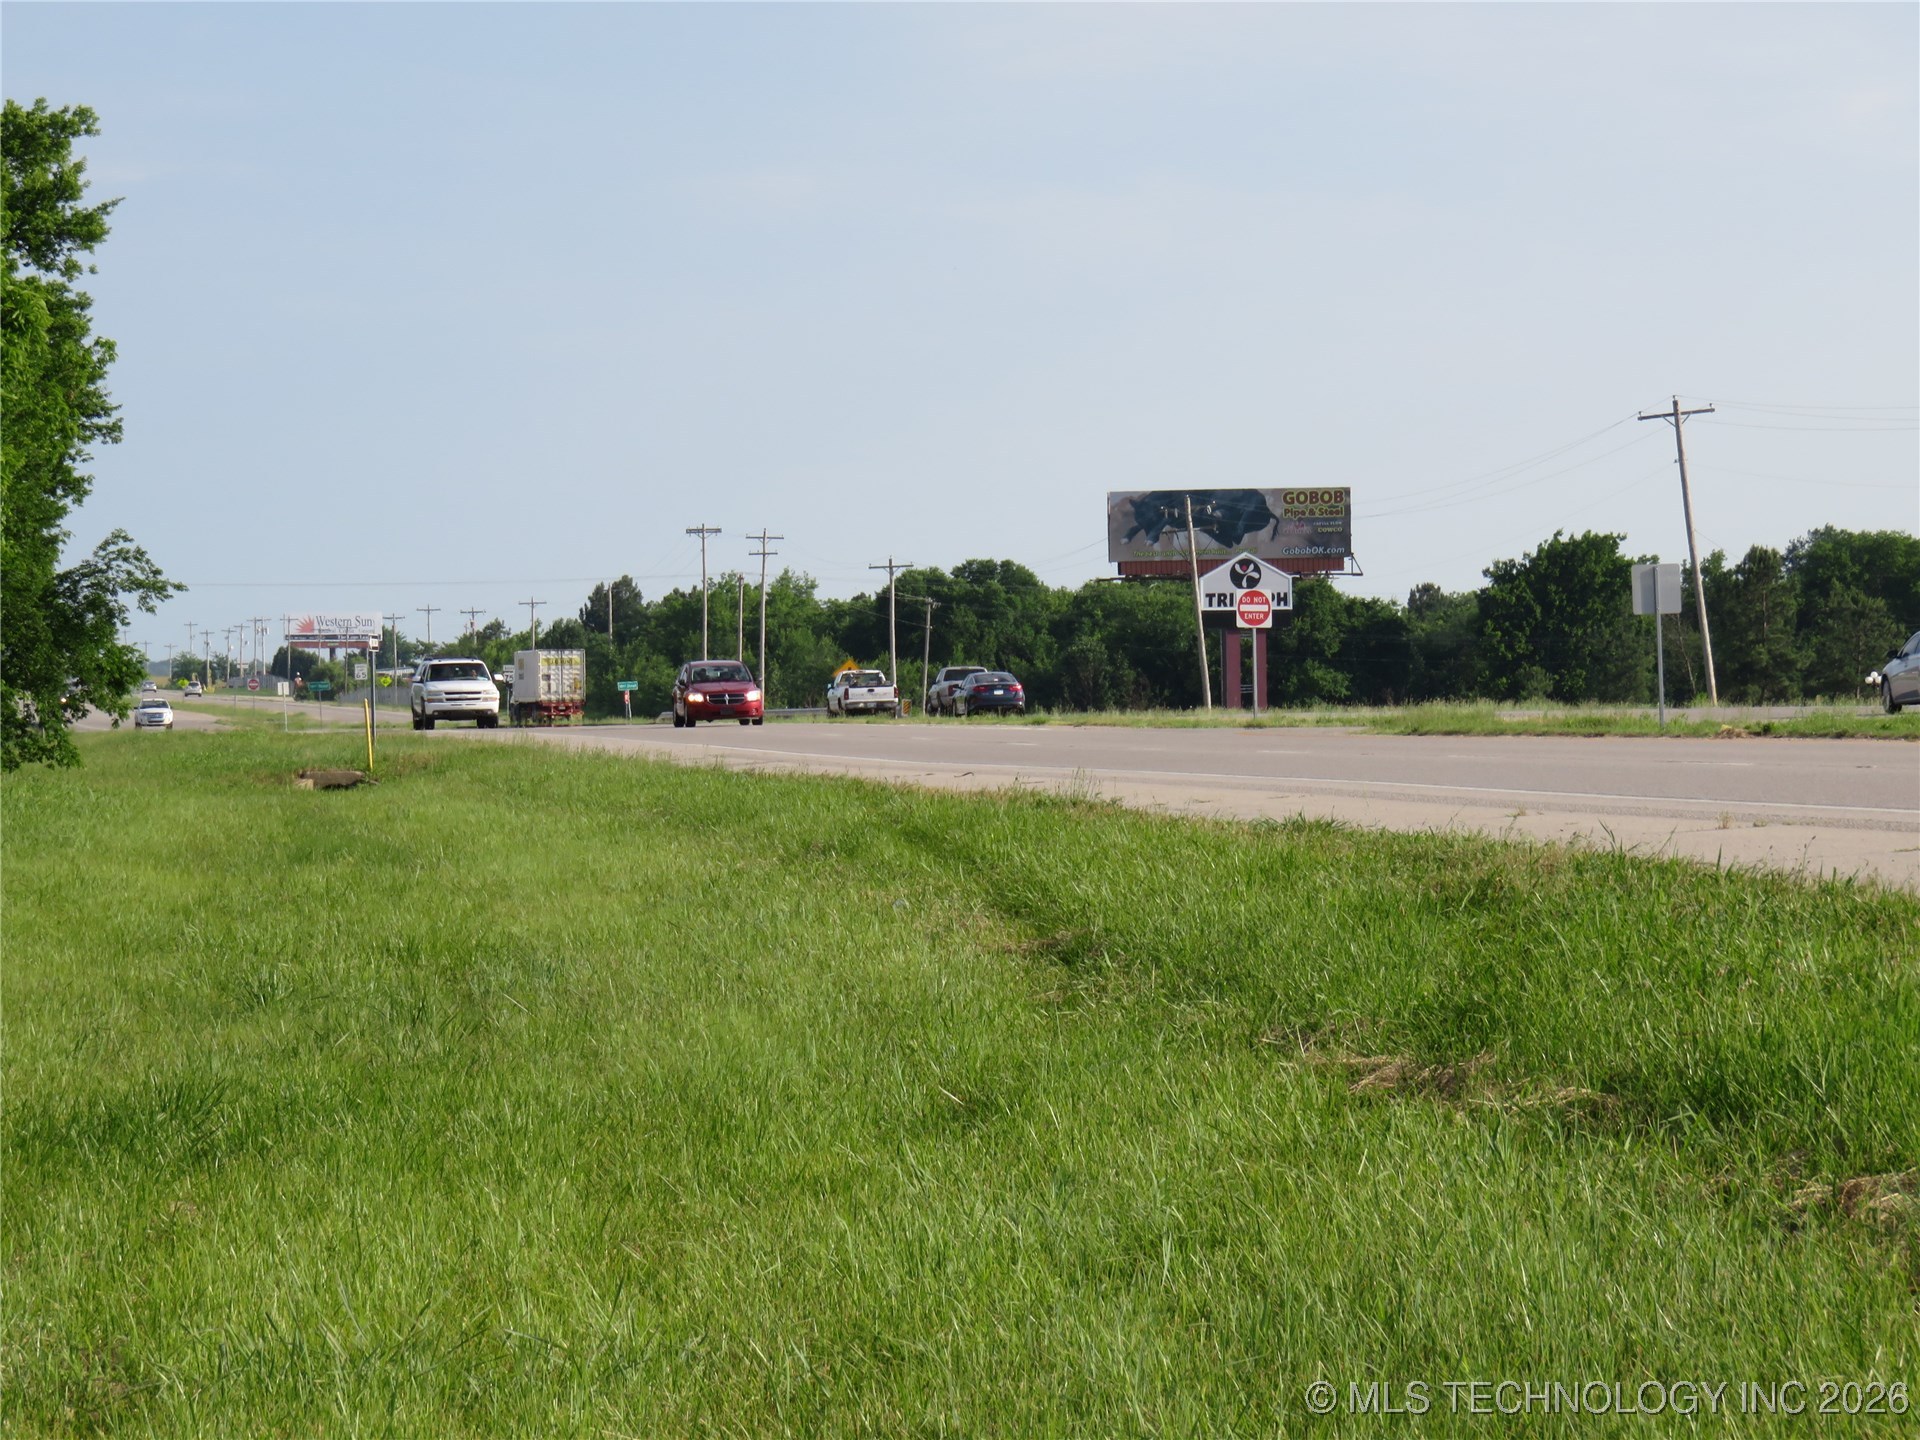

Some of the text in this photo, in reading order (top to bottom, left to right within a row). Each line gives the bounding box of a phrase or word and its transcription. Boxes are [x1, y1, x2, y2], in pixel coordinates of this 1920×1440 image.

[1282, 490, 1344, 505] GOBOB
[1283, 506, 1345, 519] Pipe & Steel
[1282, 546, 1345, 555] GobobOK.com
[1205, 592, 1288, 608] TRIH
[315, 615, 373, 627] Western Sun
[356, 671, 367, 679] 65
